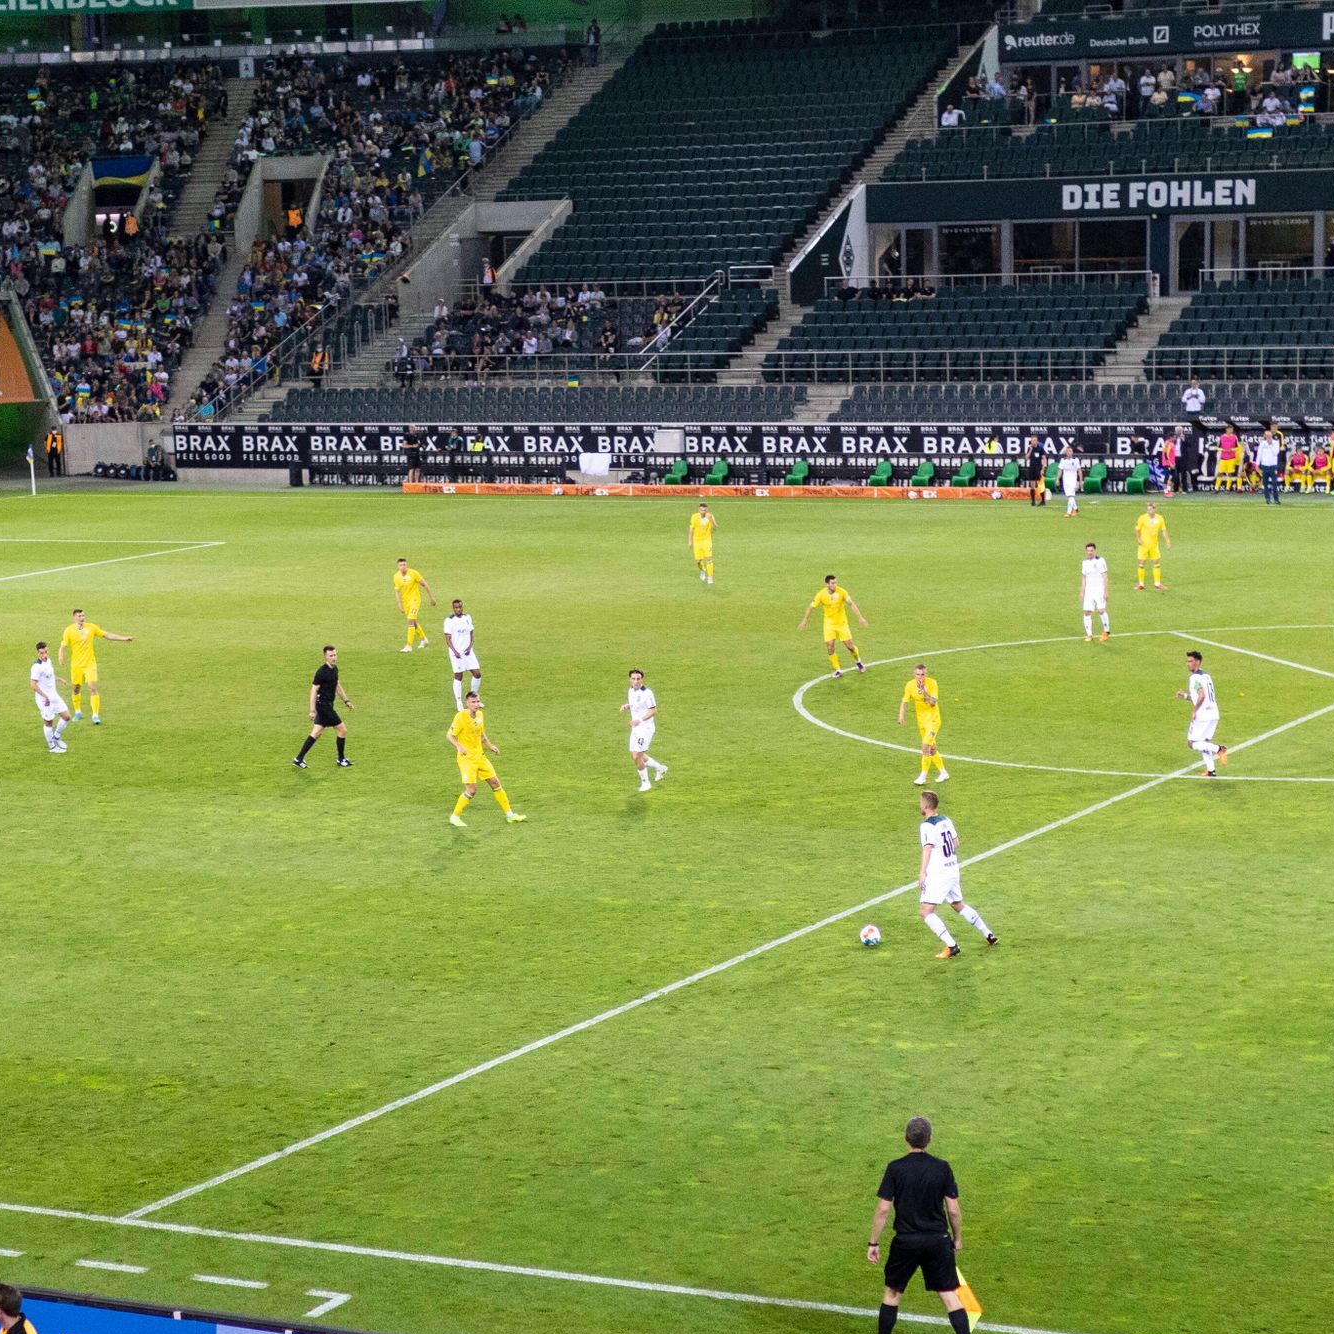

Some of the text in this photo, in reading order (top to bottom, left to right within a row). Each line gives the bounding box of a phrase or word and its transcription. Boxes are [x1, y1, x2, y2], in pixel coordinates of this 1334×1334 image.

[1193, 24, 1261, 38] POLYTHEX
[1017, 32, 1075, 48] reuter.de
[1090, 36, 1149, 48] Deutsche Bank
[1062, 179, 1257, 211] DIE FOHLEN
[175, 435, 231, 452] BRAX
[242, 435, 299, 452] BRAX
[310, 436, 367, 452] BRAX
[380, 436, 437, 452] BRX
[524, 436, 585, 453] BRAX
[598, 436, 657, 453] BRAX
[686, 437, 748, 453] BRAX
[763, 437, 827, 454] BRAX
[842, 437, 908, 454] BRAX
[923, 437, 987, 454] BRAX
[1007, 437, 1075, 454] BAX
[204, 453, 231, 461] GOOD
[941, 830, 957, 858] 30
